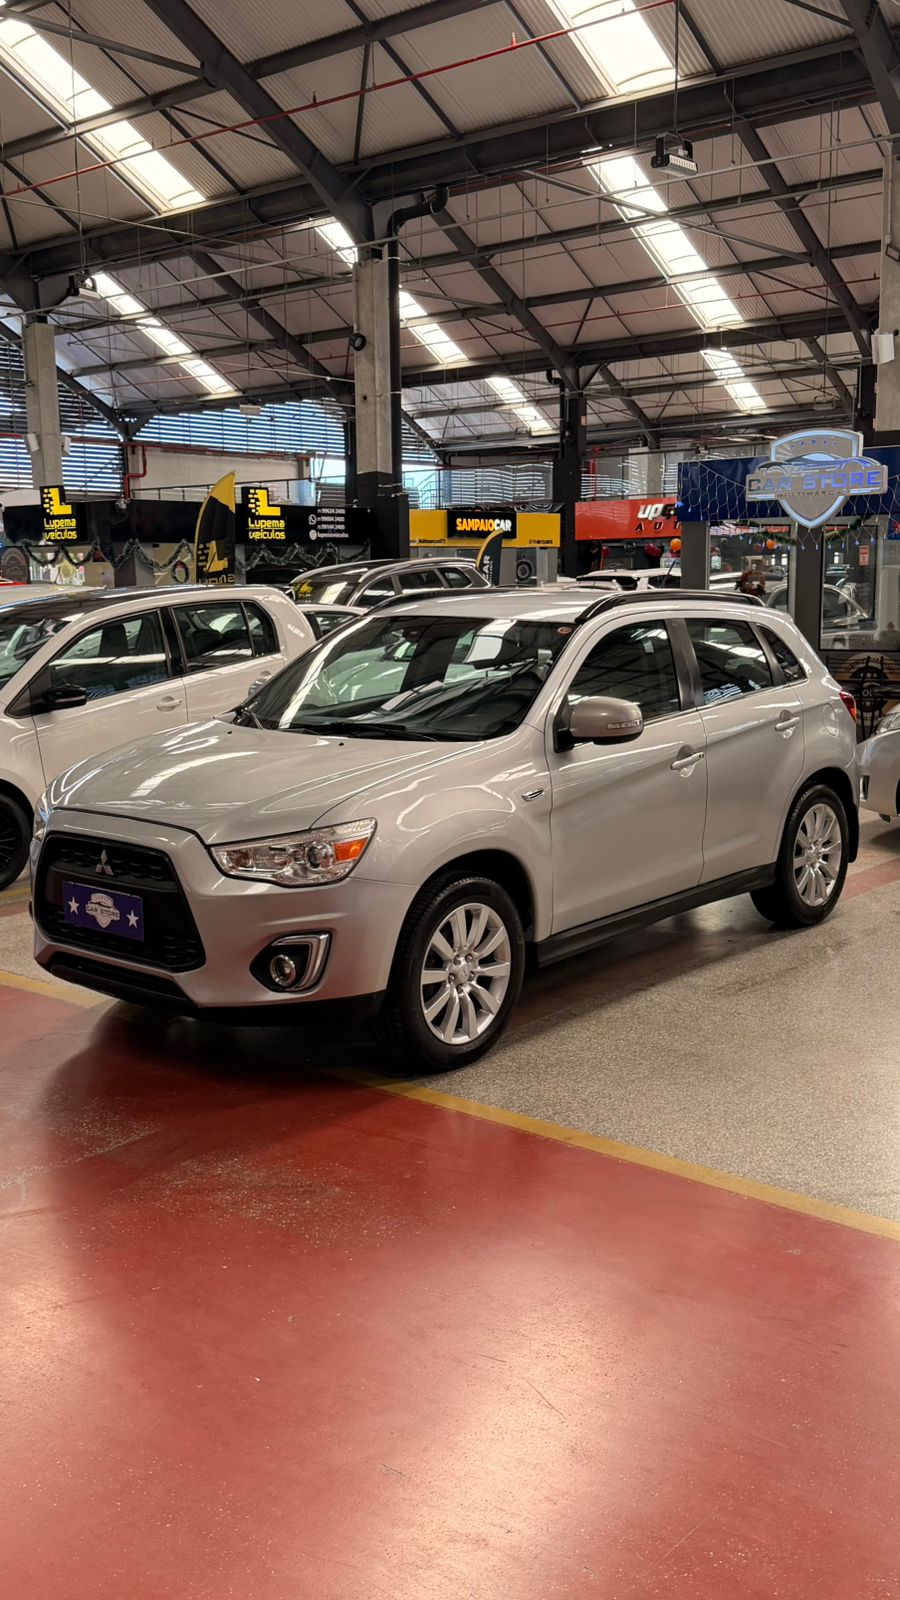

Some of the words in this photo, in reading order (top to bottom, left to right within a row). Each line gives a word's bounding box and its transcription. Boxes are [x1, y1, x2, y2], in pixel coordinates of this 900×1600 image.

[748, 476, 793, 492] CAR
[802, 471, 881, 490] STORE
[43, 518, 77, 529] Lupema
[248, 517, 286, 529] Lupema
[456, 518, 512, 531] SAMPAIOCAR
